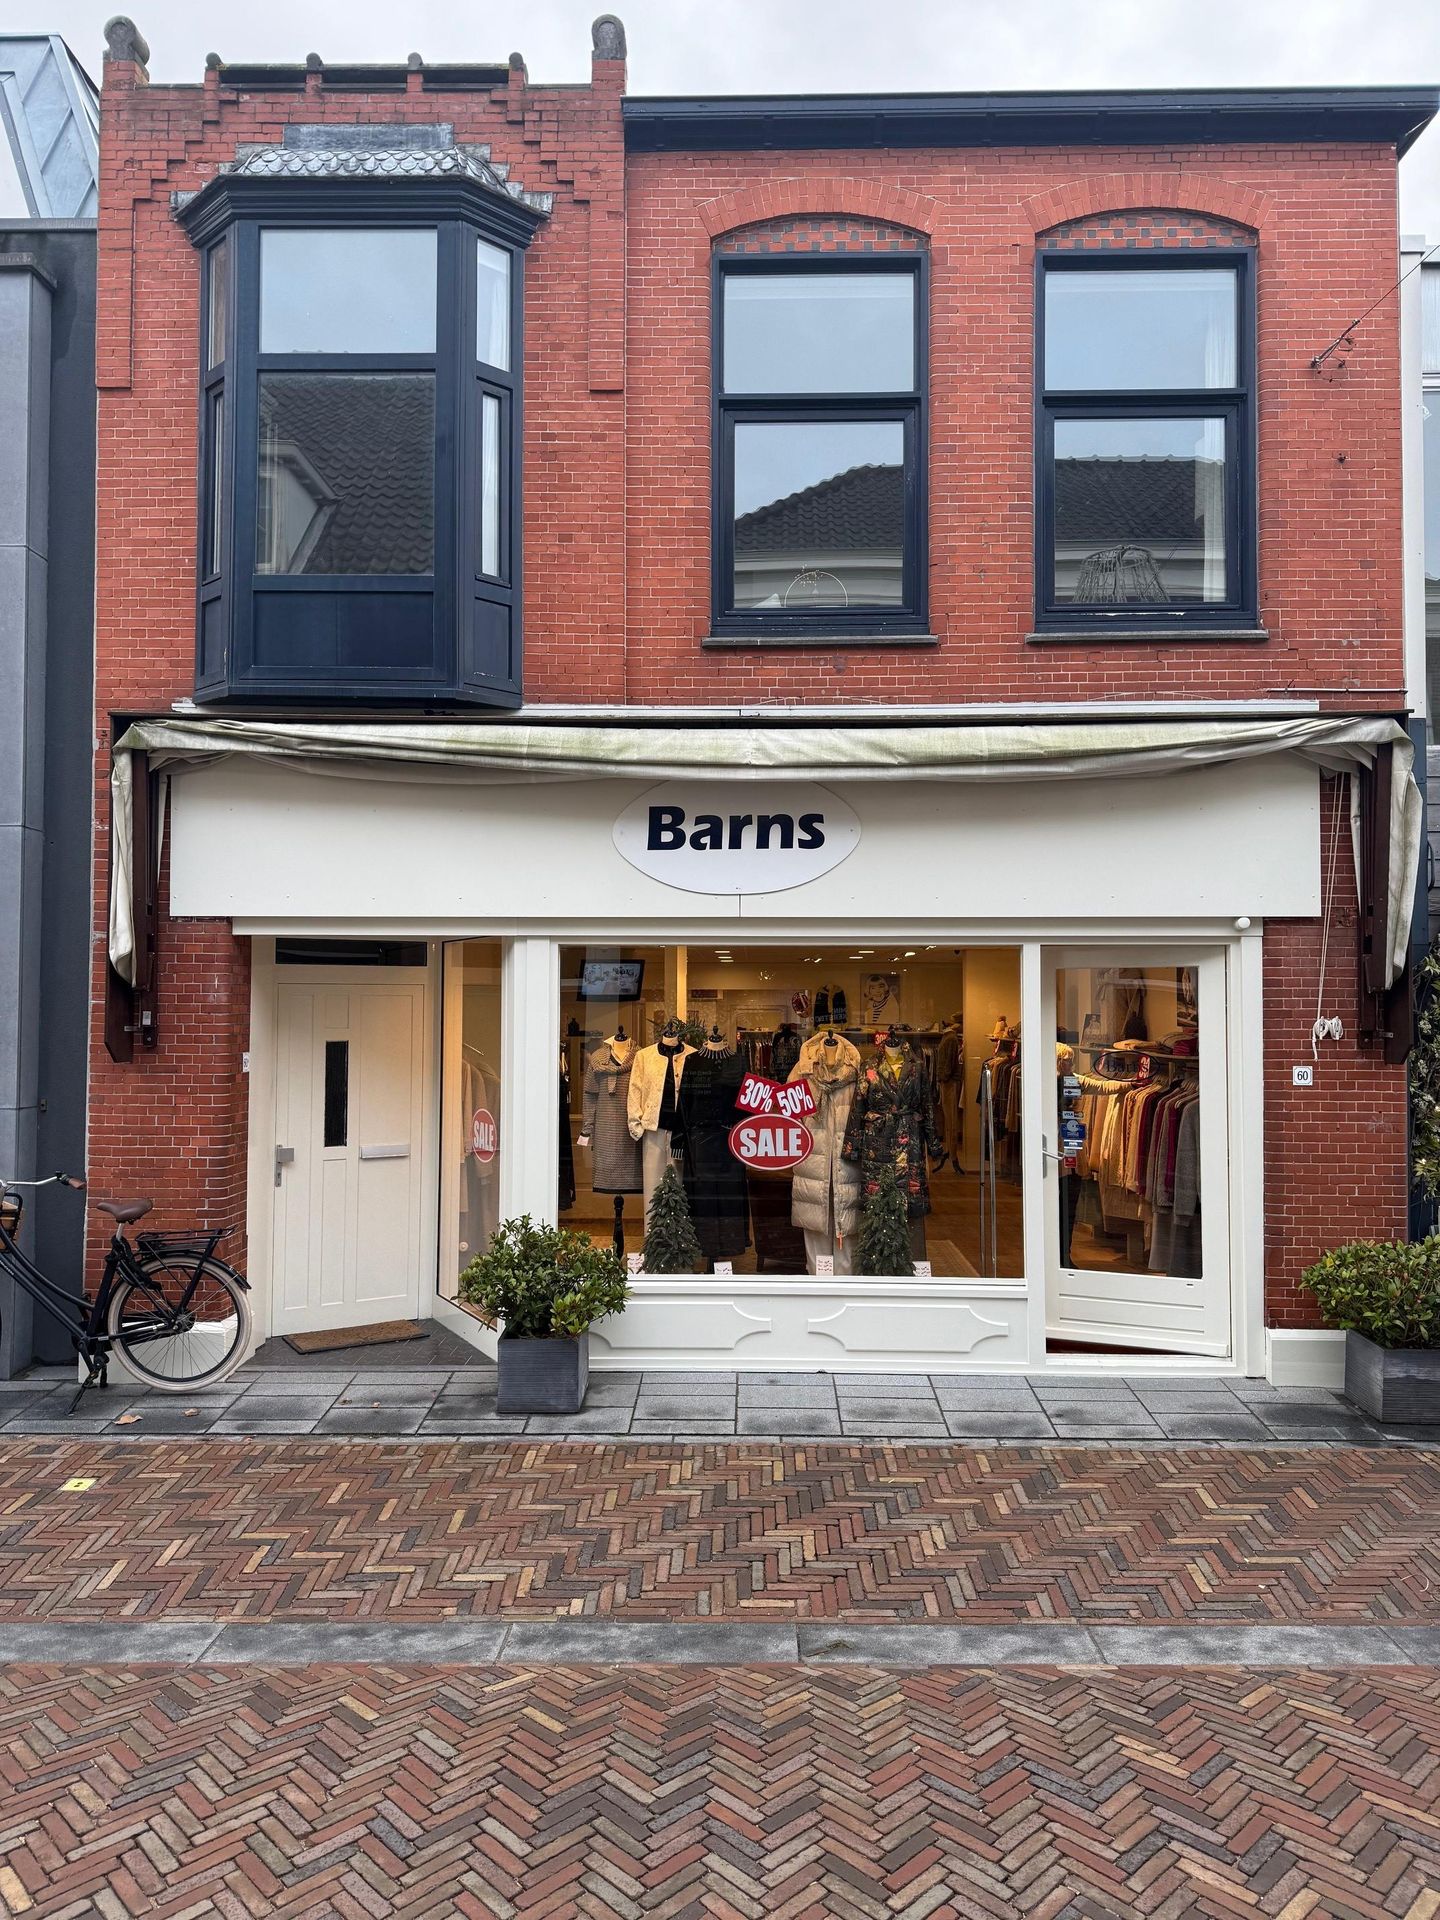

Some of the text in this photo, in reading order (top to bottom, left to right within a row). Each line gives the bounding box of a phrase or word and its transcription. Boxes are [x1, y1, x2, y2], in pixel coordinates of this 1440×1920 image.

[646, 805, 825, 851] Barns
[1297, 1070, 1309, 1081] 60
[740, 1078, 775, 1112] 30%
[776, 1083, 813, 1117] 50%
[473, 1120, 494, 1153] SALE
[739, 1127, 803, 1158] SALE
